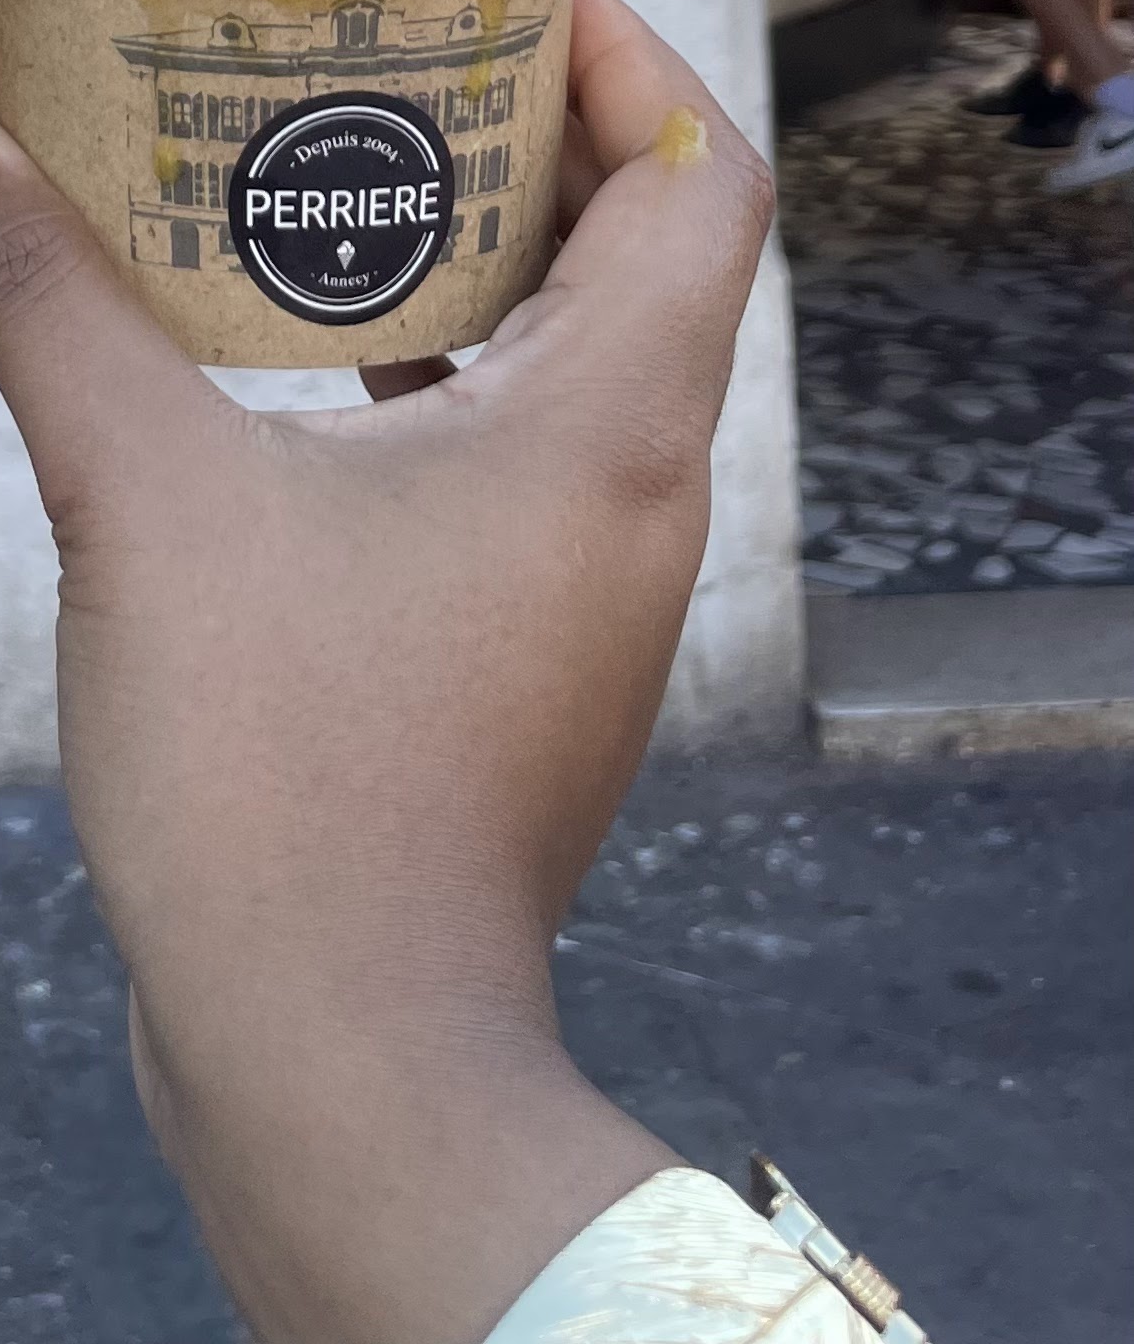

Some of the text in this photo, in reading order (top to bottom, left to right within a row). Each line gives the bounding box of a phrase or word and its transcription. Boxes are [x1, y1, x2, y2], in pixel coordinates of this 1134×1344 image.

[294, 131, 400, 164] Depuis 2004
[246, 181, 441, 229] PERRIERE
[318, 271, 370, 287] Annecy
